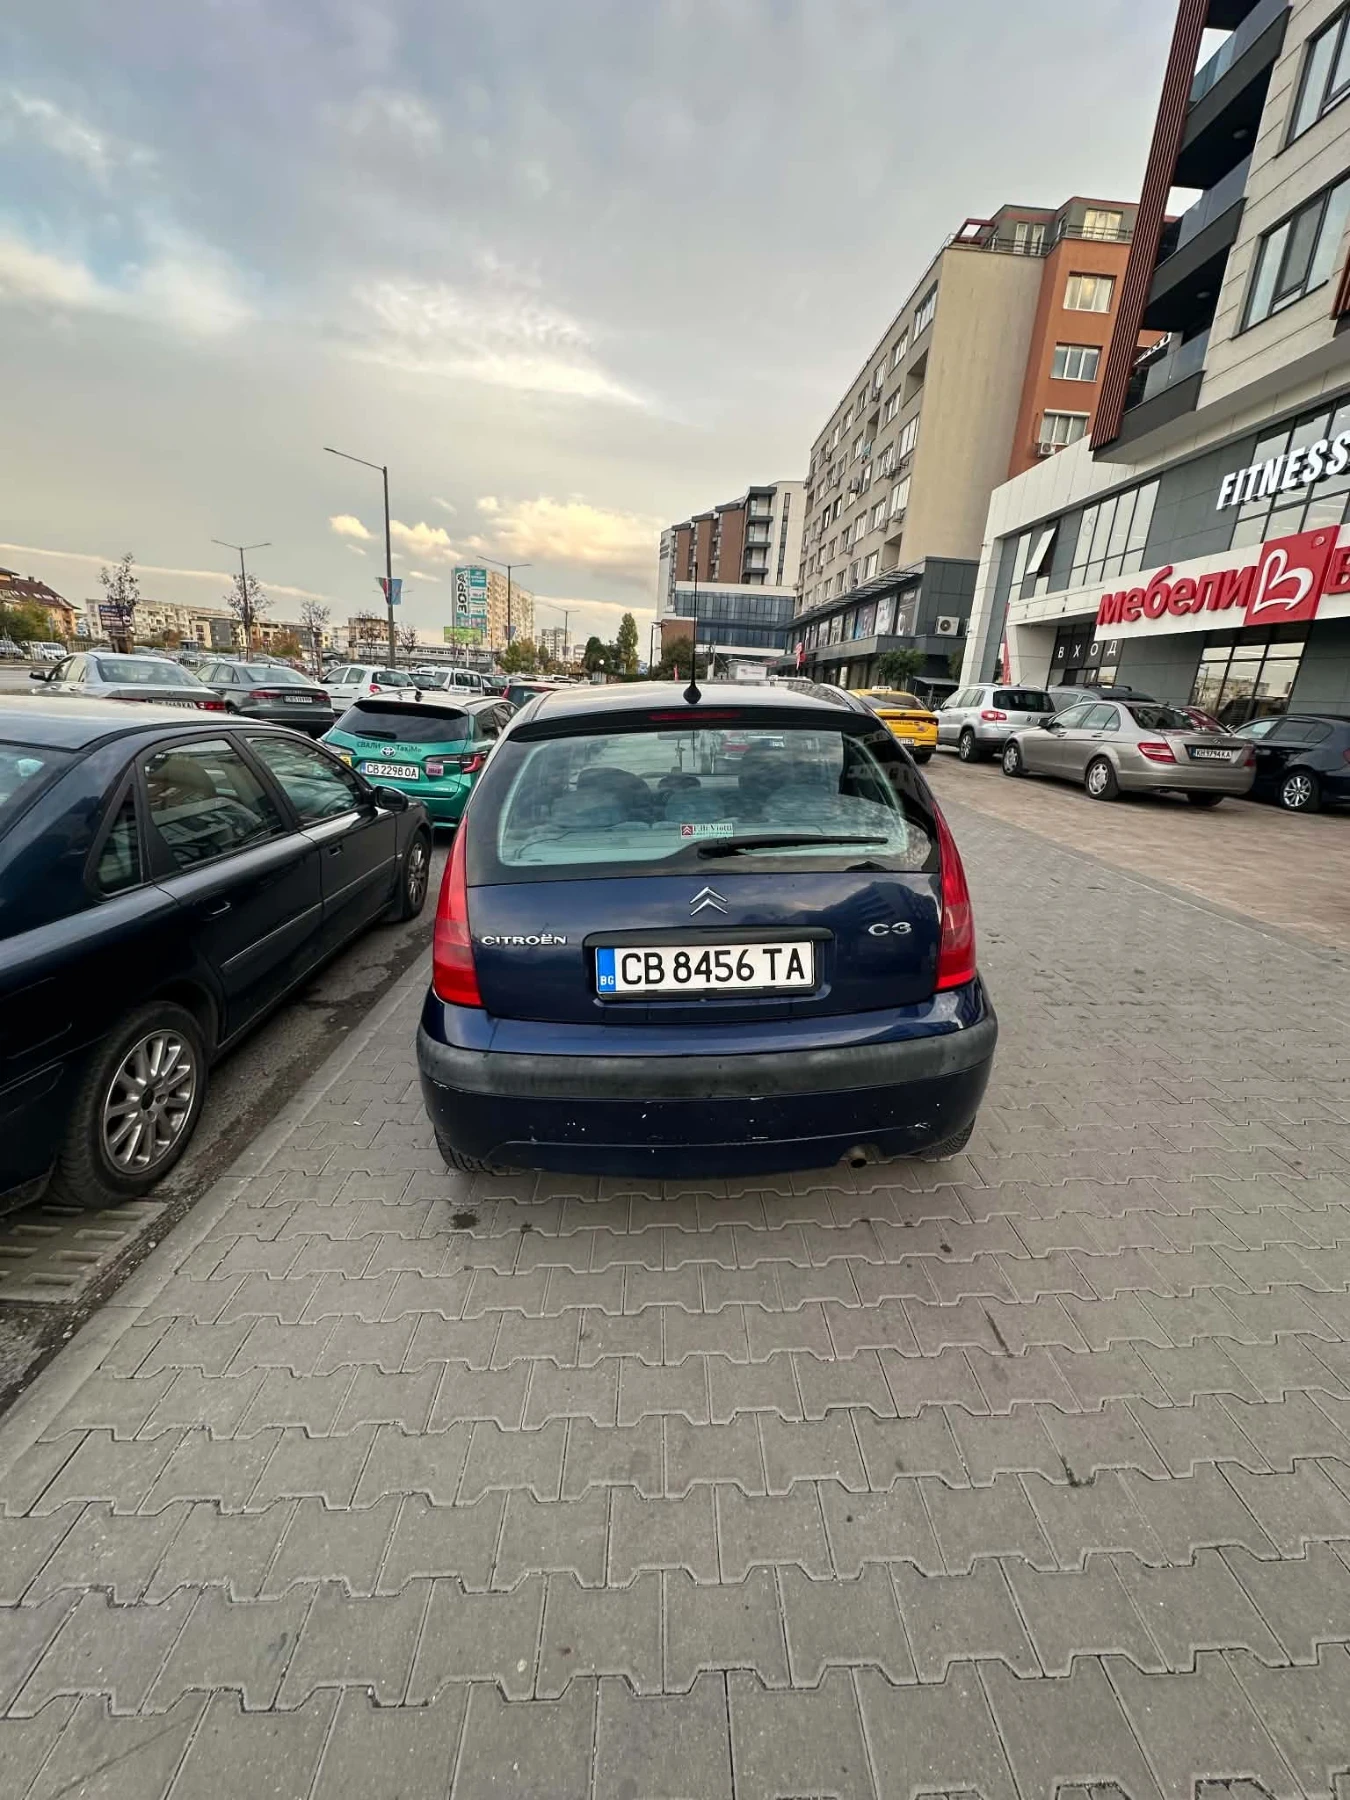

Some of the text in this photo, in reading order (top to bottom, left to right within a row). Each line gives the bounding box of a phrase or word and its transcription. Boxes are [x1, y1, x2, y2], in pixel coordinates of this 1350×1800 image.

[1216, 430, 1350, 510] FITNESS
[1096, 565, 1258, 626] мебели
[380, 765, 403, 776] 2298
[868, 921, 912, 936] C3
[481, 933, 566, 946] CITROËN
[673, 949, 755, 983] 8456
[600, 975, 615, 985] BG
